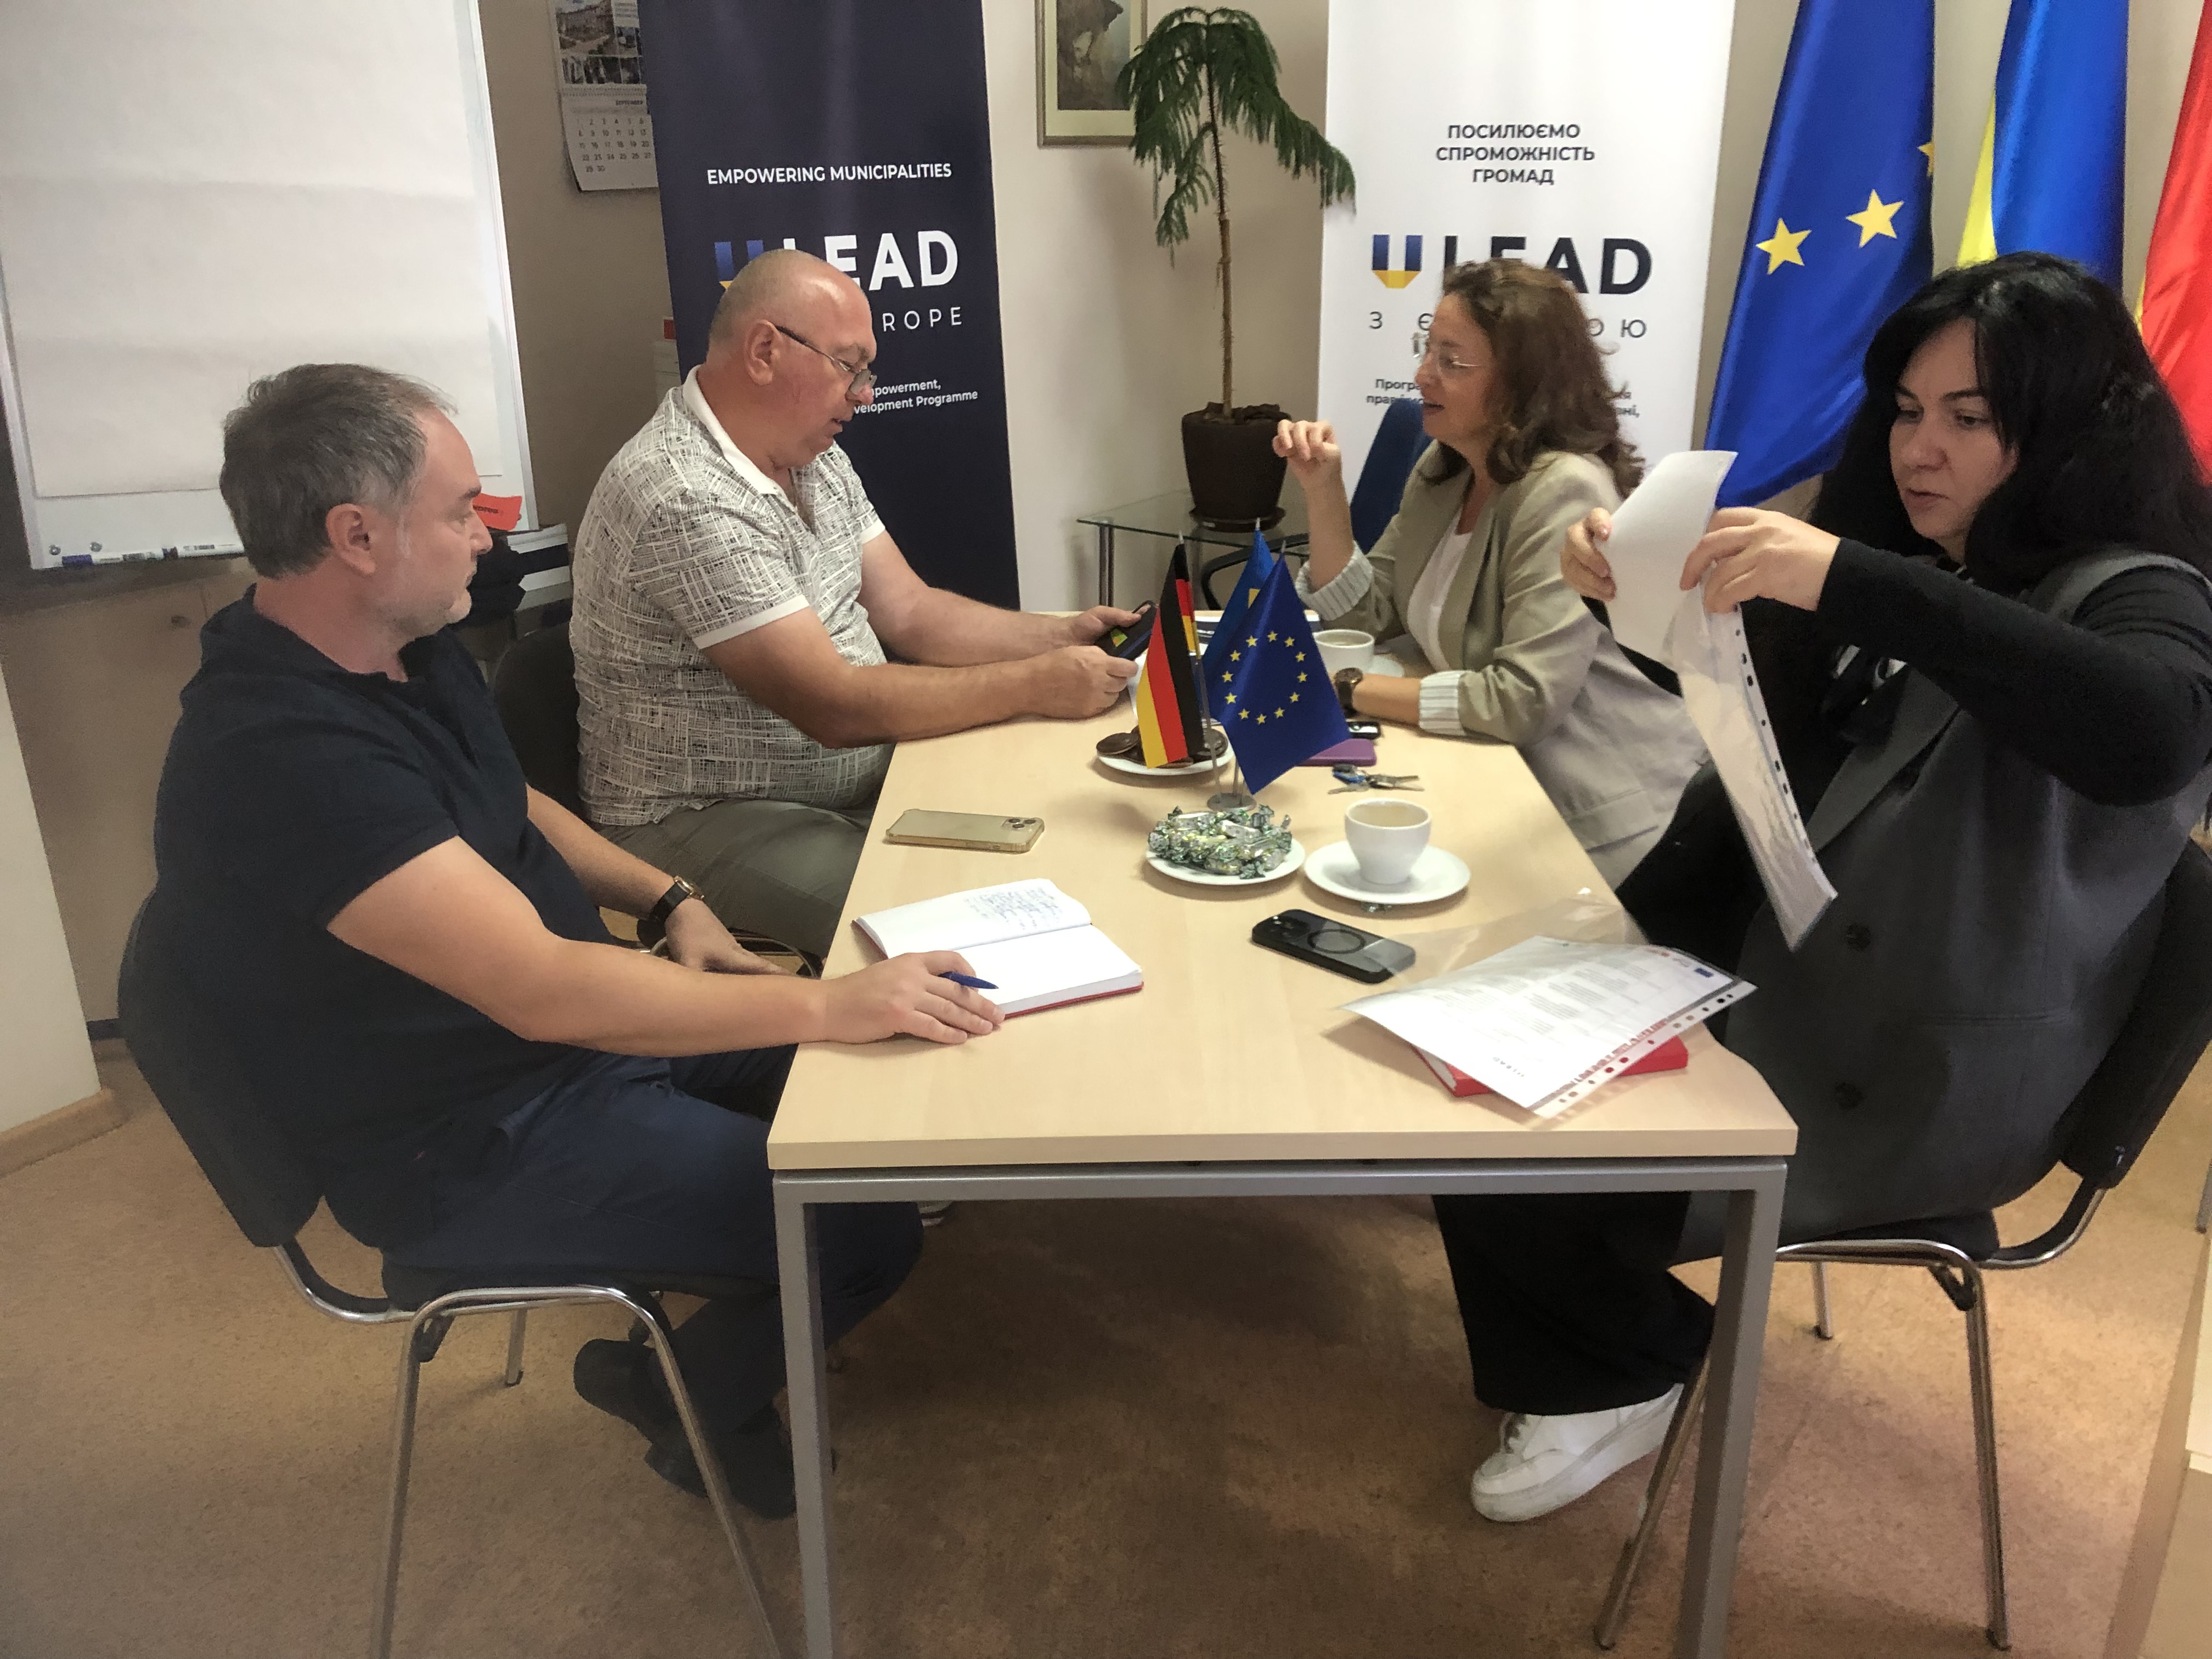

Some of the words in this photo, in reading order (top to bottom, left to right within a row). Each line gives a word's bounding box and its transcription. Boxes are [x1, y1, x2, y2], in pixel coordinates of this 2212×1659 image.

[1448, 124, 1581, 138] ПОСИЛЮЄМО
[1436, 146, 1595, 161] СПРОМОЖНІСТЬ
[707, 166, 825, 184] EMPOWERING
[830, 163, 952, 181] MUNICIPALITIES
[1472, 168, 1554, 185] ГРОМАД
[783, 230, 958, 291] EAD
[882, 307, 962, 331] ROPE
[871, 379, 941, 398] powerment,
[1375, 379, 1422, 392] Прогр
[854, 398, 913, 414] velopment
[916, 391, 978, 407] Programme
